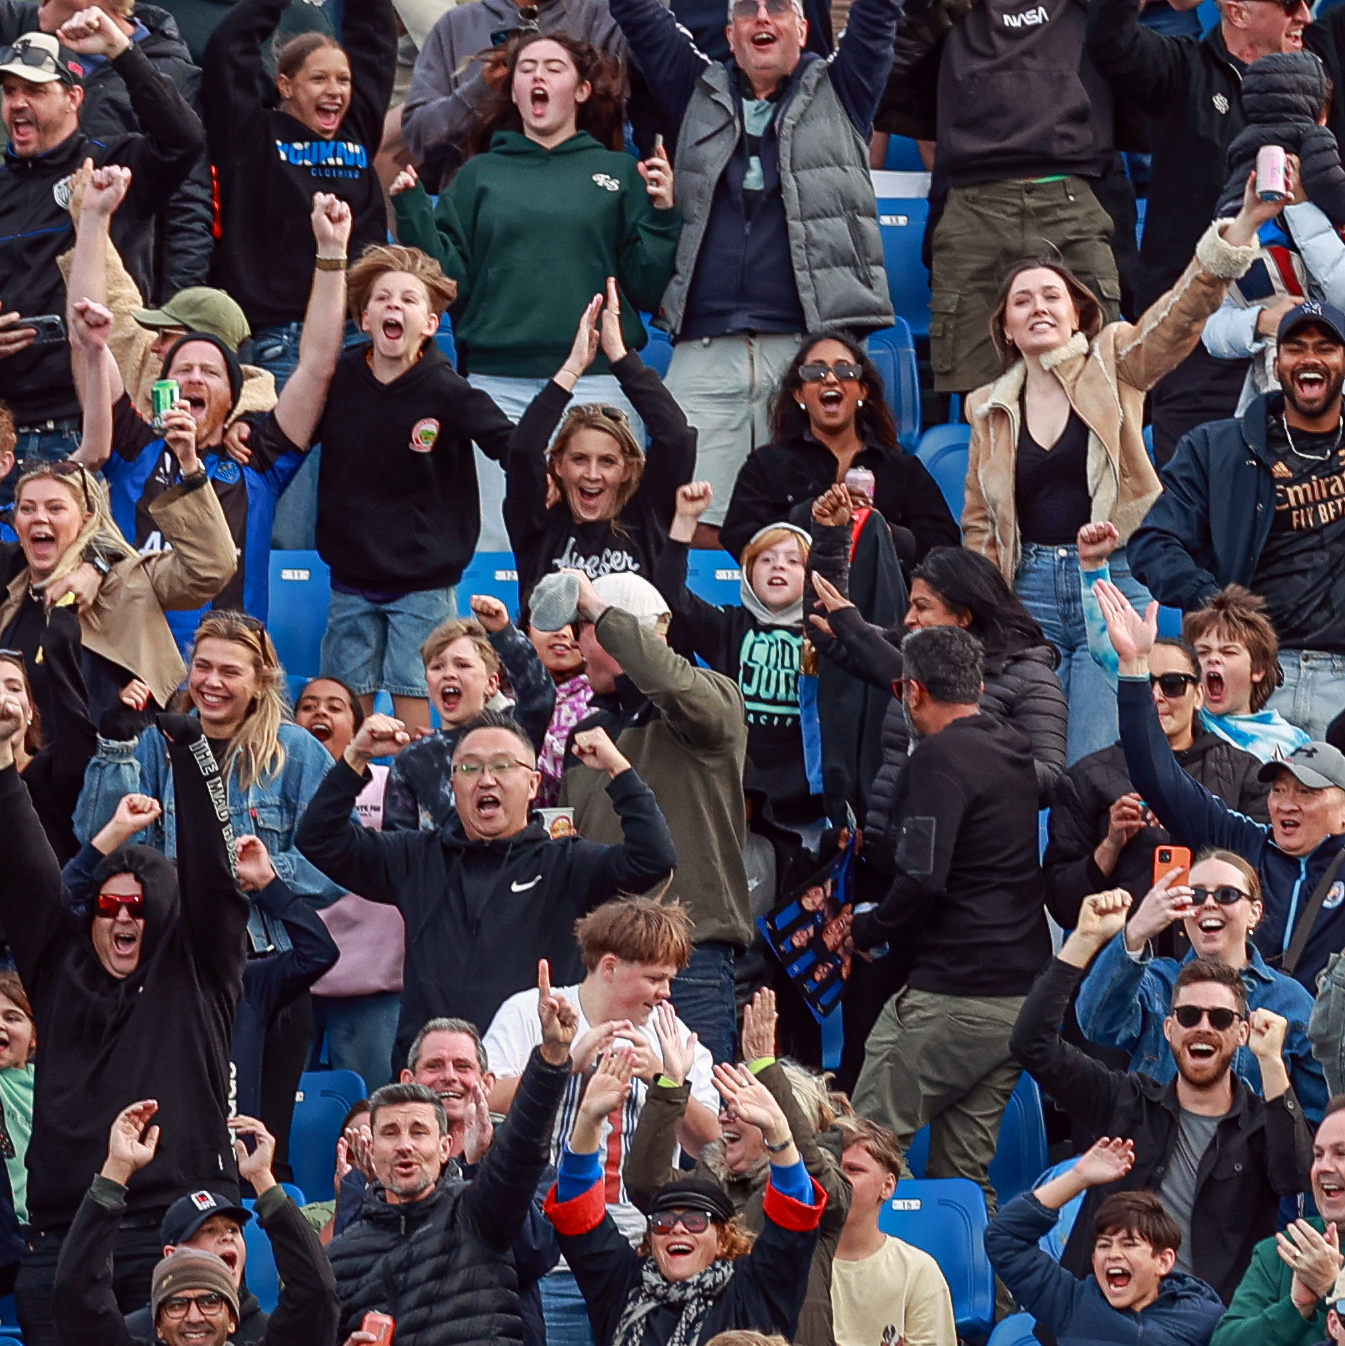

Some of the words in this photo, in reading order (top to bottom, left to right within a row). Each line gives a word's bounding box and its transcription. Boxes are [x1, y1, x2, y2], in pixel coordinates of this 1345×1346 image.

[1001, 6, 1048, 28] NASA
[1275, 472, 1345, 512] Emira
[1319, 500, 1345, 523] BET
